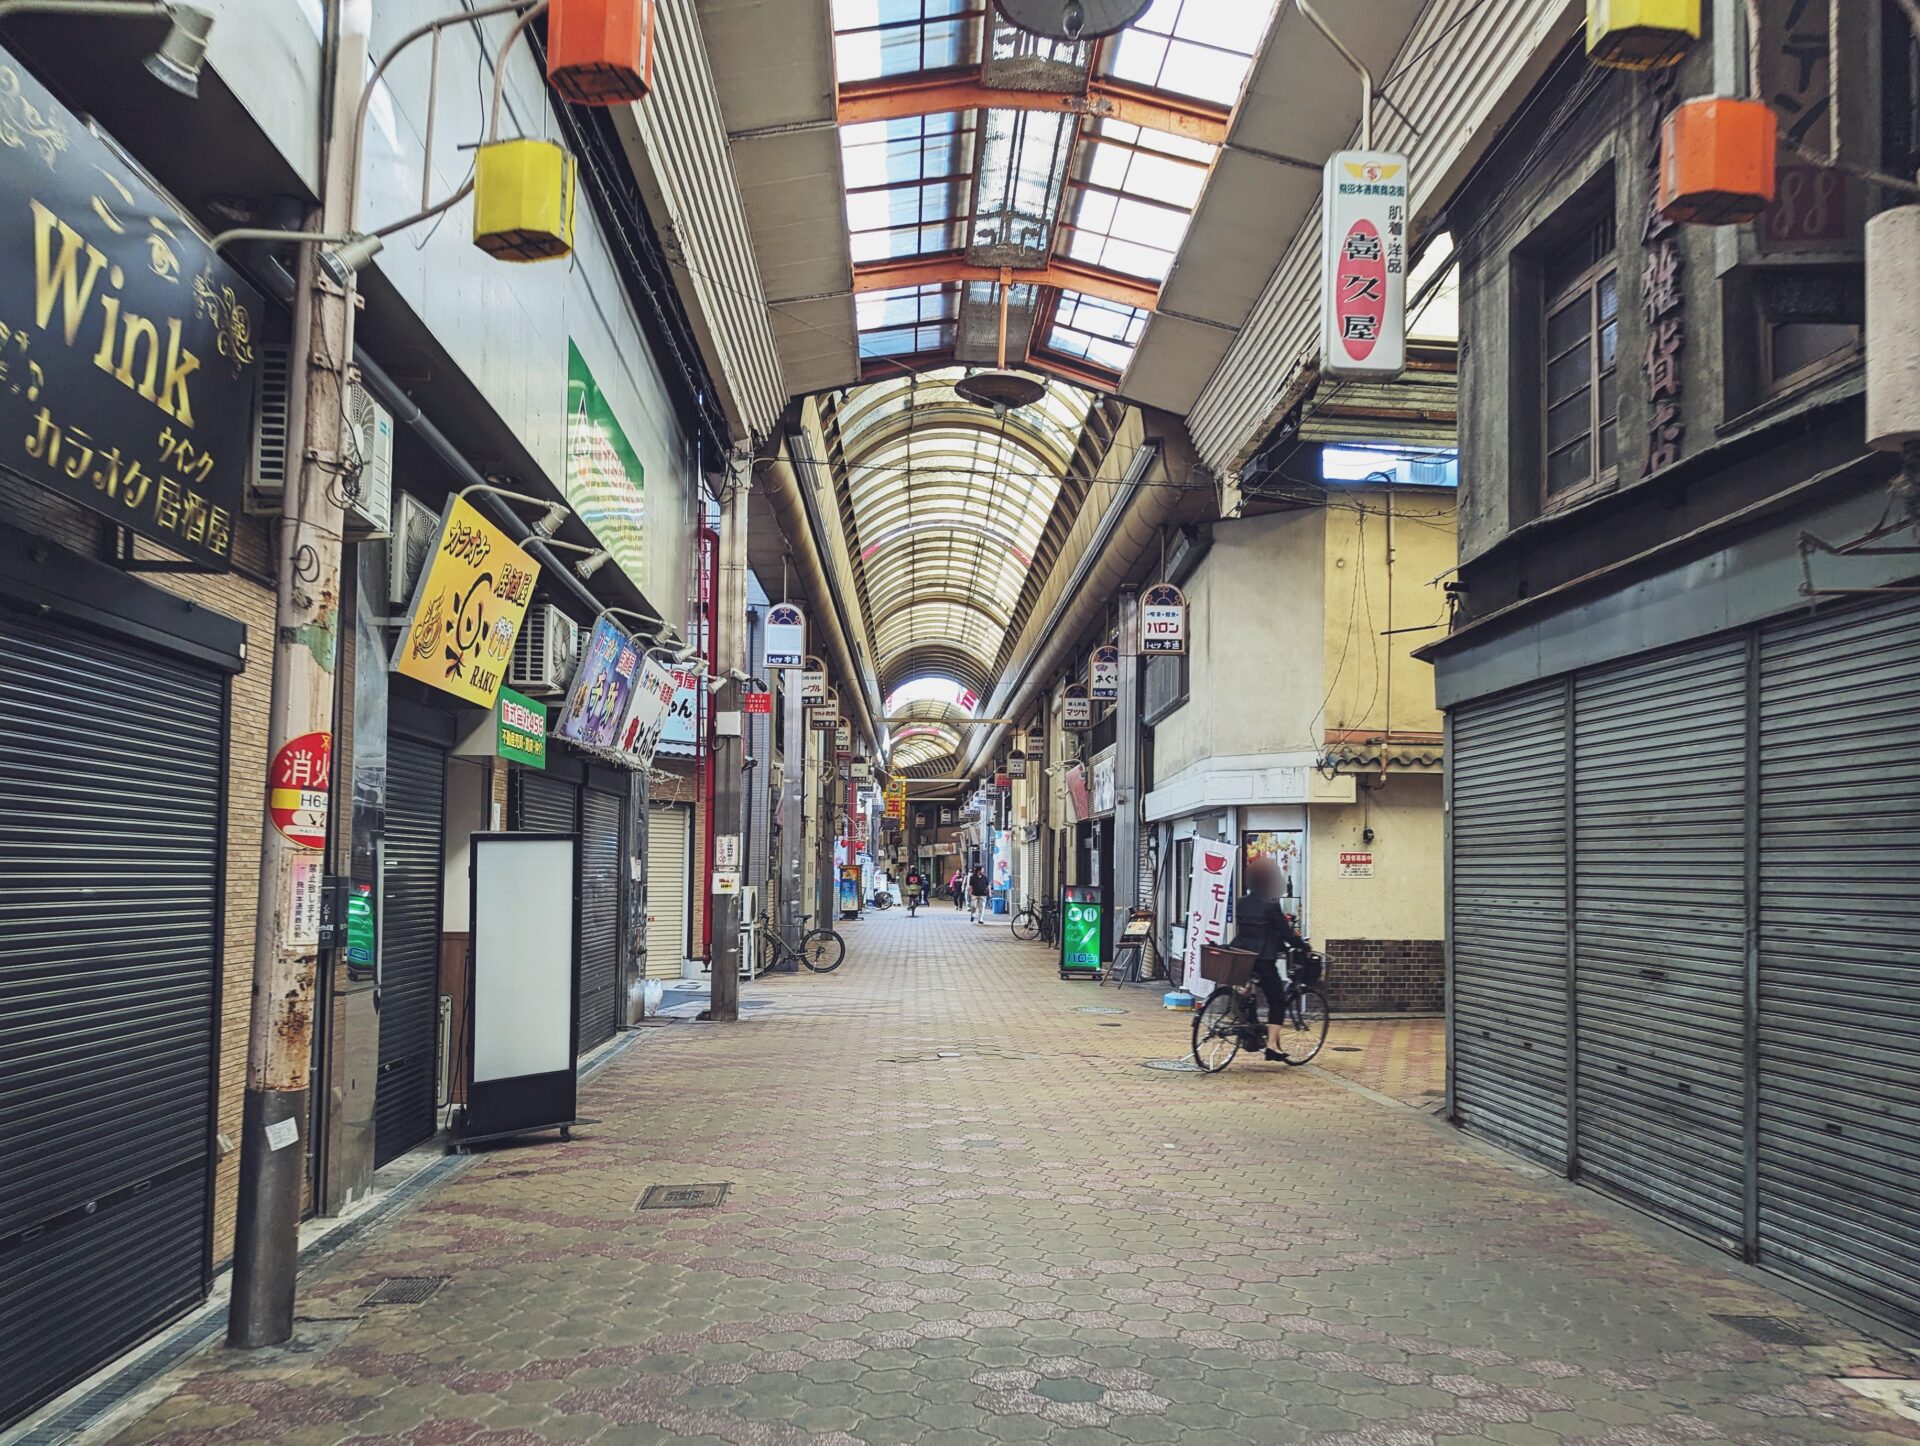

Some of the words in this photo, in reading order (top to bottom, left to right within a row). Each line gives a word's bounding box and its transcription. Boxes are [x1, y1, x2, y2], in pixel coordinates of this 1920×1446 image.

[1339, 183, 1405, 197] 飛田本通南商店街
[1387, 205, 1403, 273] 肌着・洋品
[29, 197, 200, 430] Wink
[1640, 203, 1680, 478] 雑貨店
[443, 520, 491, 569] カラオケ
[493, 563, 533, 608] 居酒屋
[594, 632, 619, 663] カラオケ
[1146, 621, 1179, 634] バロン
[469, 664, 499, 694] RAKU
[502, 698, 545, 737] 株式会社456
[1066, 708, 1088, 717] マツヤ
[1204, 883, 1226, 944] モーニ
